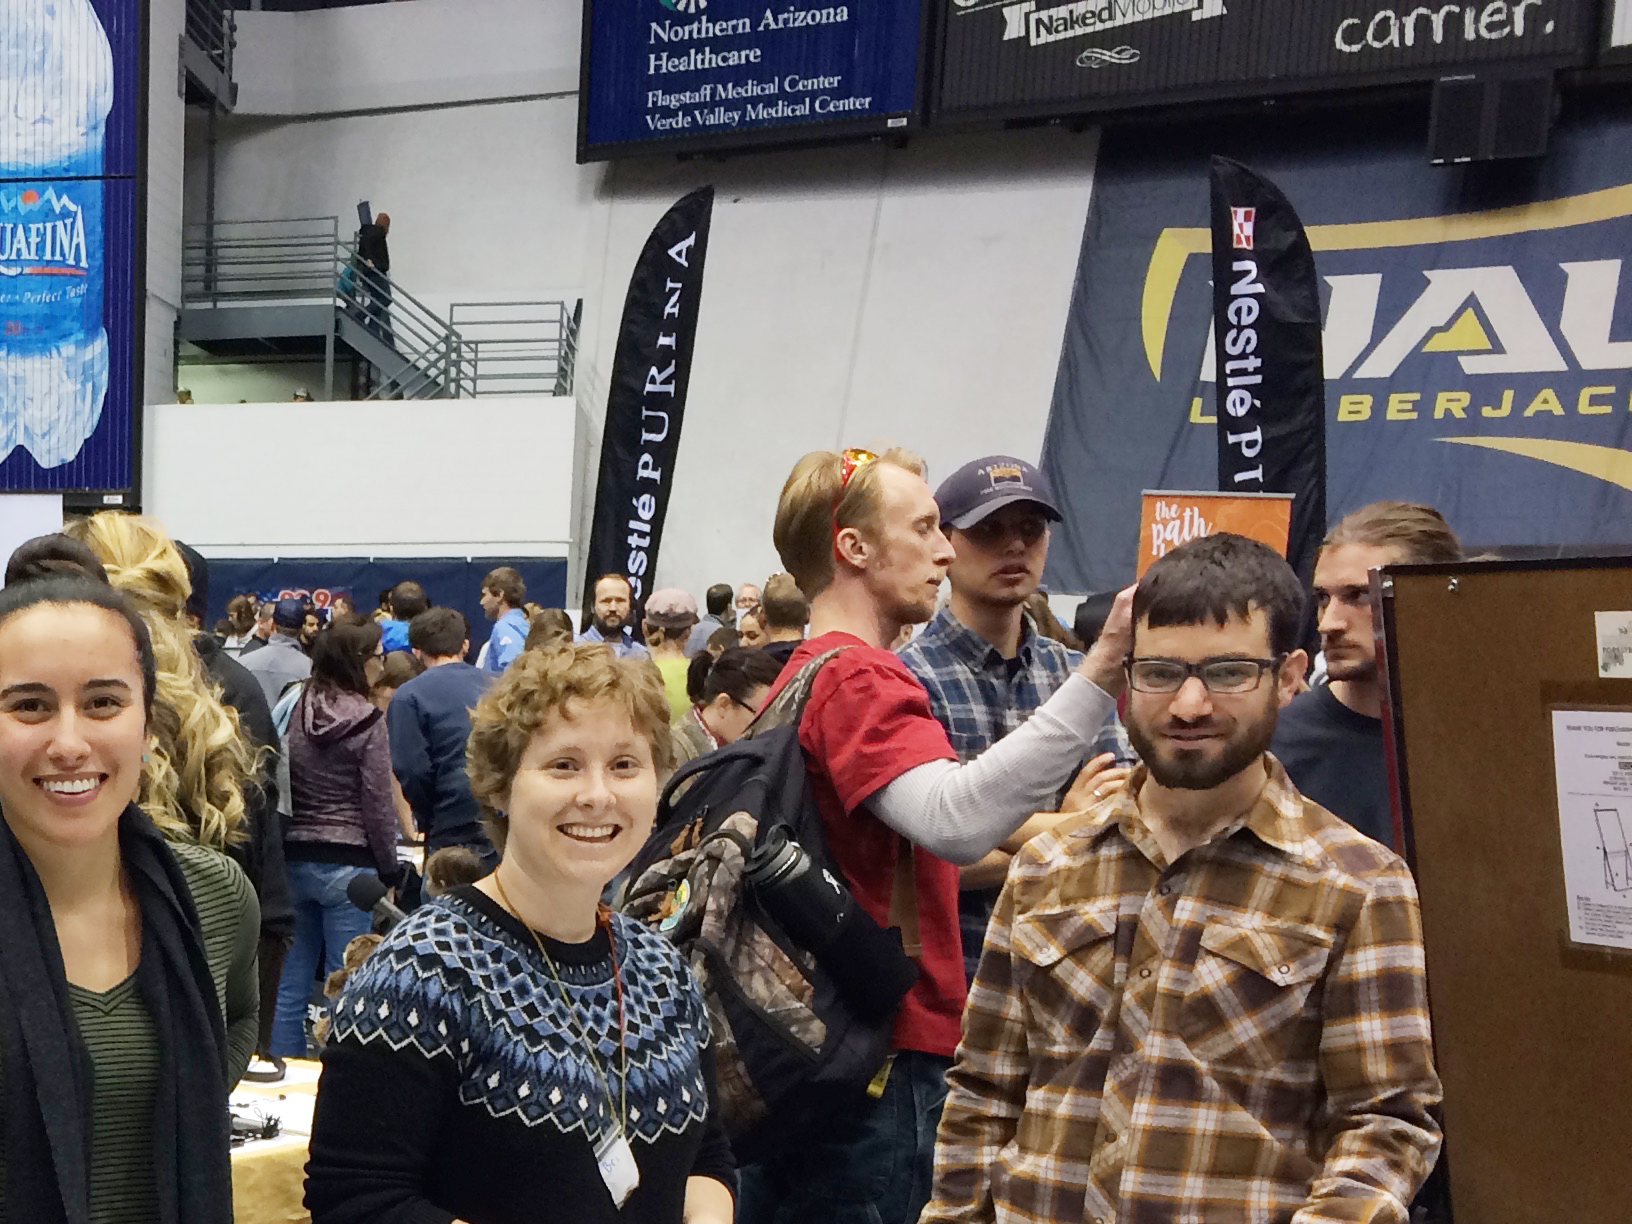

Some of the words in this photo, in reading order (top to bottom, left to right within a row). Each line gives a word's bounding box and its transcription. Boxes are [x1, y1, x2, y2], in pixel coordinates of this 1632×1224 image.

[649, 16, 751, 44] Northern
[757, 5, 849, 32] Arizona
[648, 47, 762, 75] Healthcare
[646, 84, 713, 110] Flagstaff
[716, 77, 780, 101] Medical
[784, 74, 842, 93] Center
[645, 112, 692, 131] Verde
[694, 107, 742, 128] Valley
[745, 103, 811, 122] Medical
[814, 96, 872, 114] Center
[636, 231, 696, 485] PURINA
[1225, 259, 1266, 419] Nestlé
[1155, 500, 1181, 521] the
[626, 492, 657, 601] estlé
[1151, 506, 1213, 556] path
